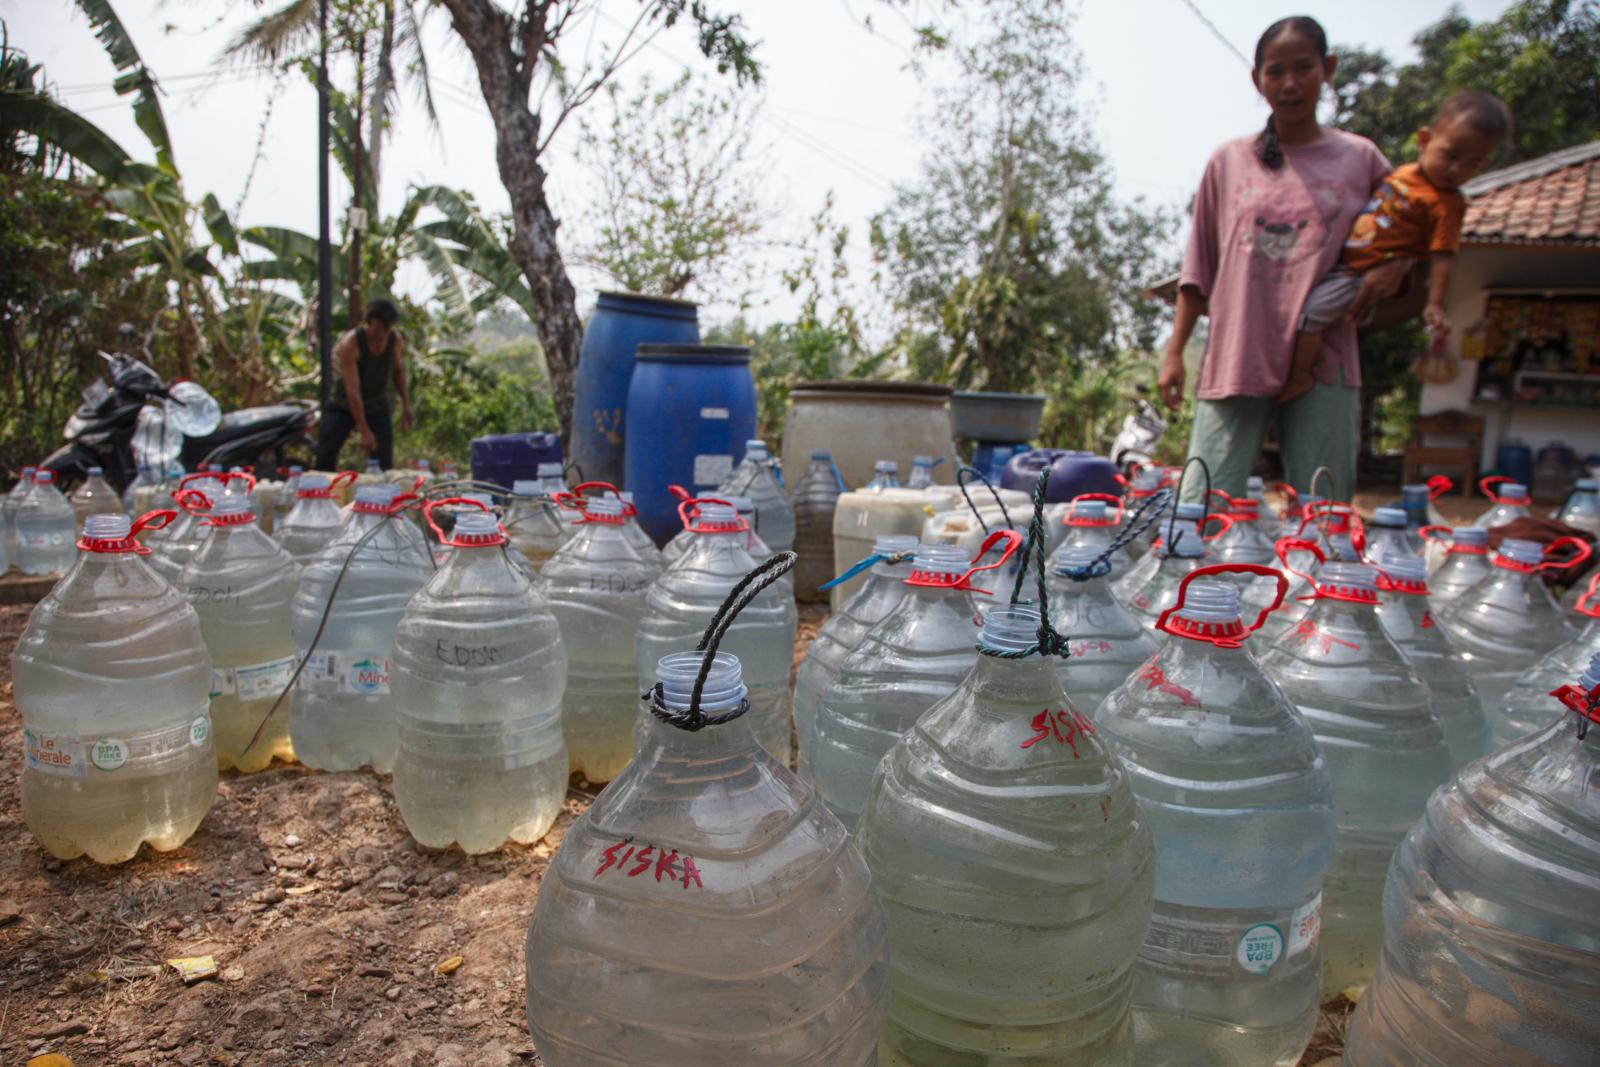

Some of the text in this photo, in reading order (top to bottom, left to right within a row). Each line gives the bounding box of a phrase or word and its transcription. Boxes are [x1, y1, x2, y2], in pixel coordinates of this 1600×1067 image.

[39, 735, 55, 750] Le
[594, 841, 703, 889] SISKA
[1247, 943, 1274, 951] FREE
[1247, 950, 1274, 961] BPA
